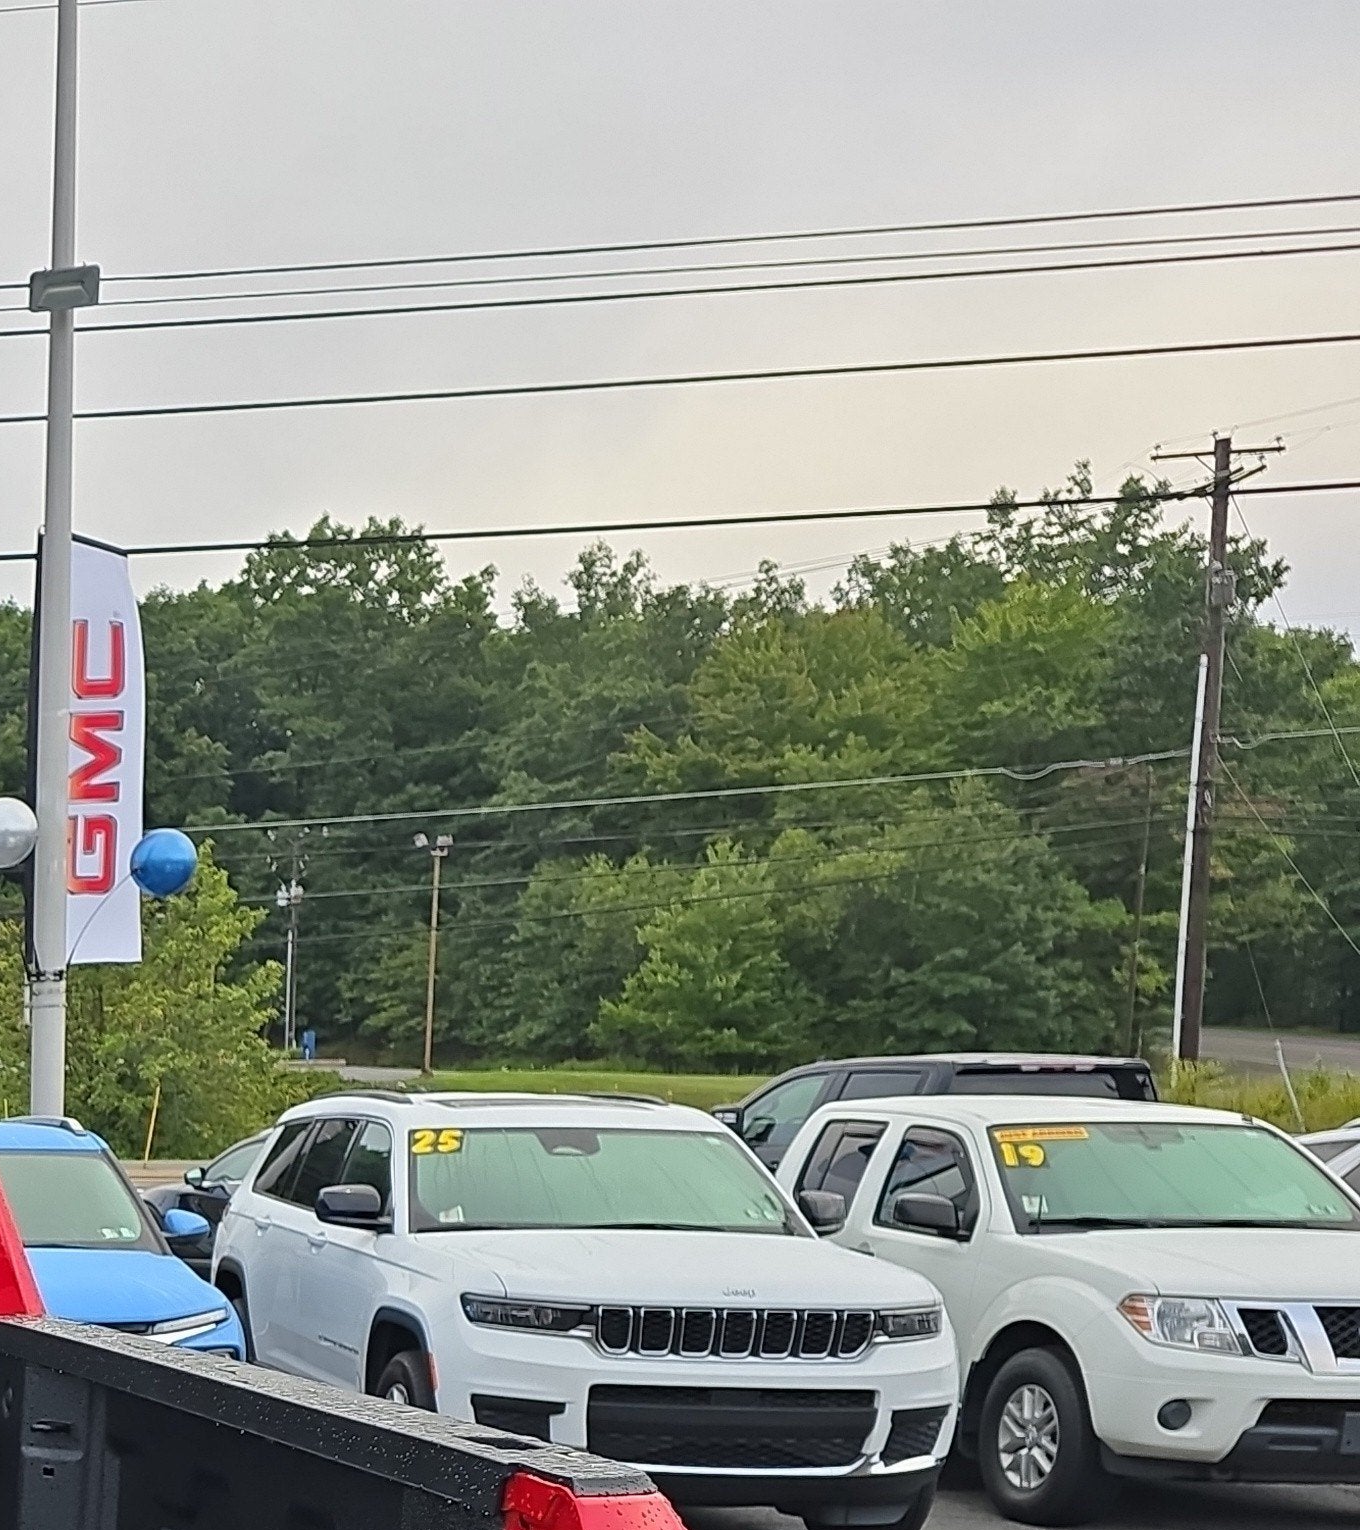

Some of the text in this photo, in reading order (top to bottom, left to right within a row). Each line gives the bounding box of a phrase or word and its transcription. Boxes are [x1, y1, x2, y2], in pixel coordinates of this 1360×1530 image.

[67, 619, 126, 895] GMC
[411, 1129, 463, 1153] 25
[1000, 1142, 1045, 1167] 19
